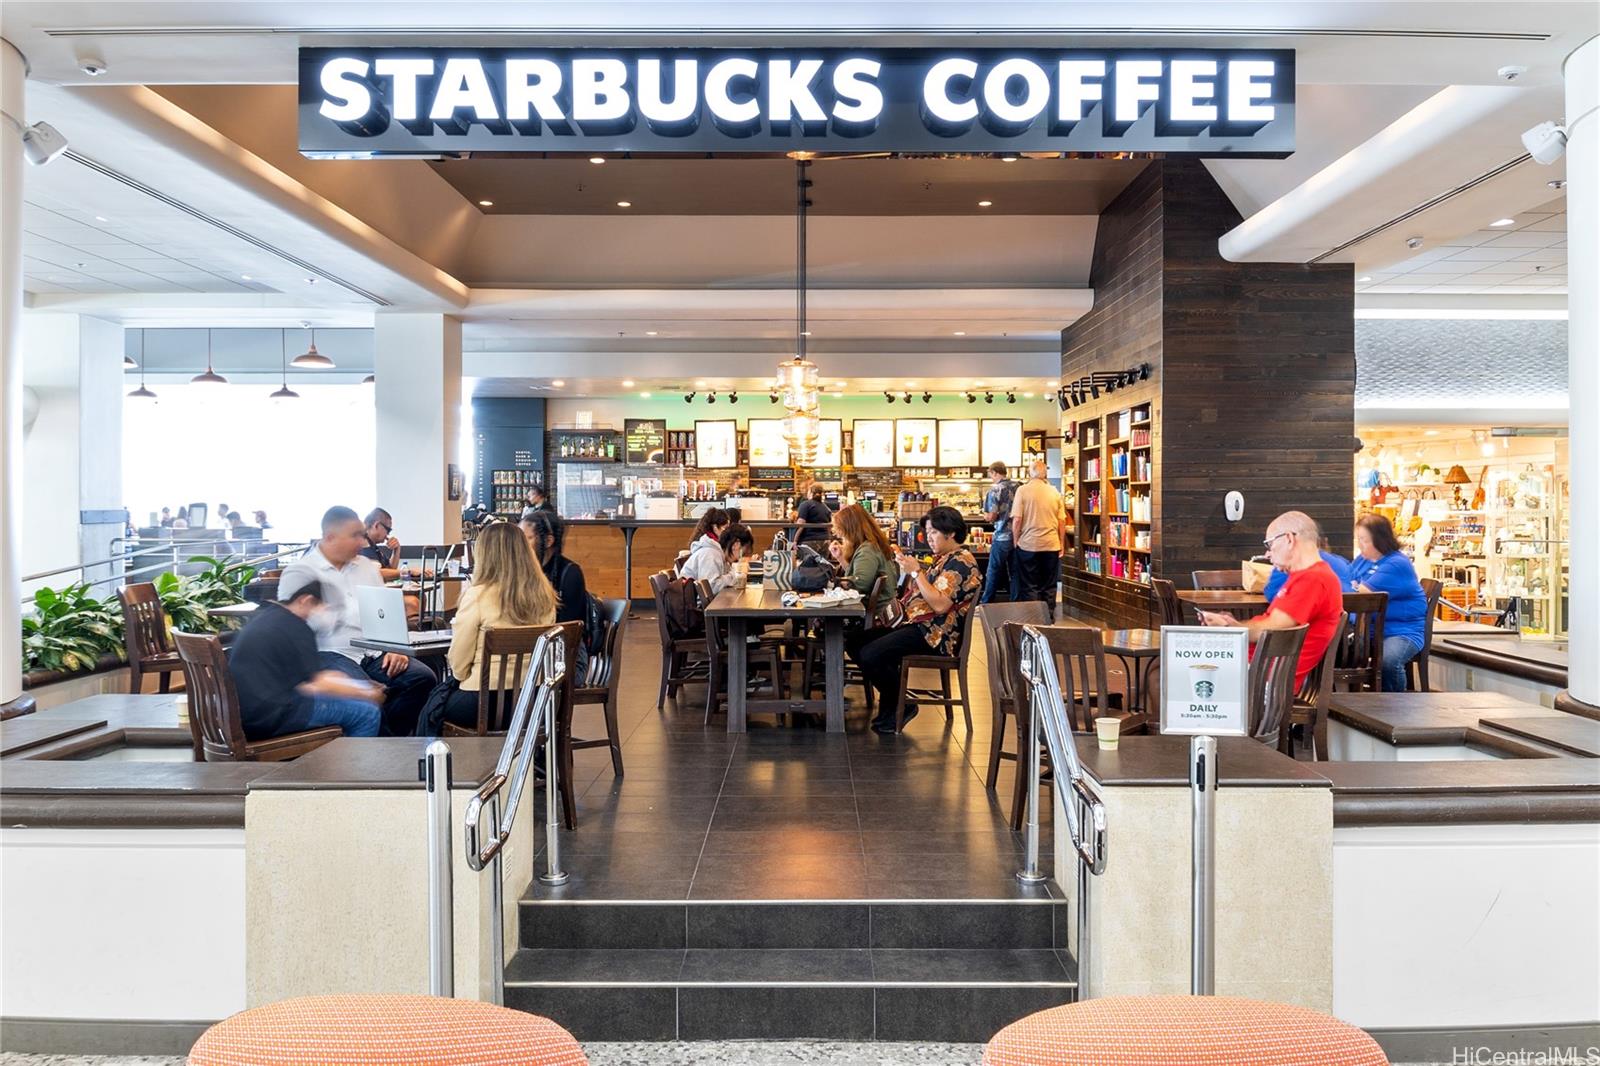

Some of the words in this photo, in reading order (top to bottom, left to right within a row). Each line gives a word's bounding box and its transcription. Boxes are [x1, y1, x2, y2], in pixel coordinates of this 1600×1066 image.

[319, 57, 885, 123] STARBUCKS
[923, 57, 1276, 123] COFFEE
[1175, 650, 1202, 658] NOW
[1205, 650, 1234, 659] OPEN
[1189, 704, 1218, 712] DAILY
